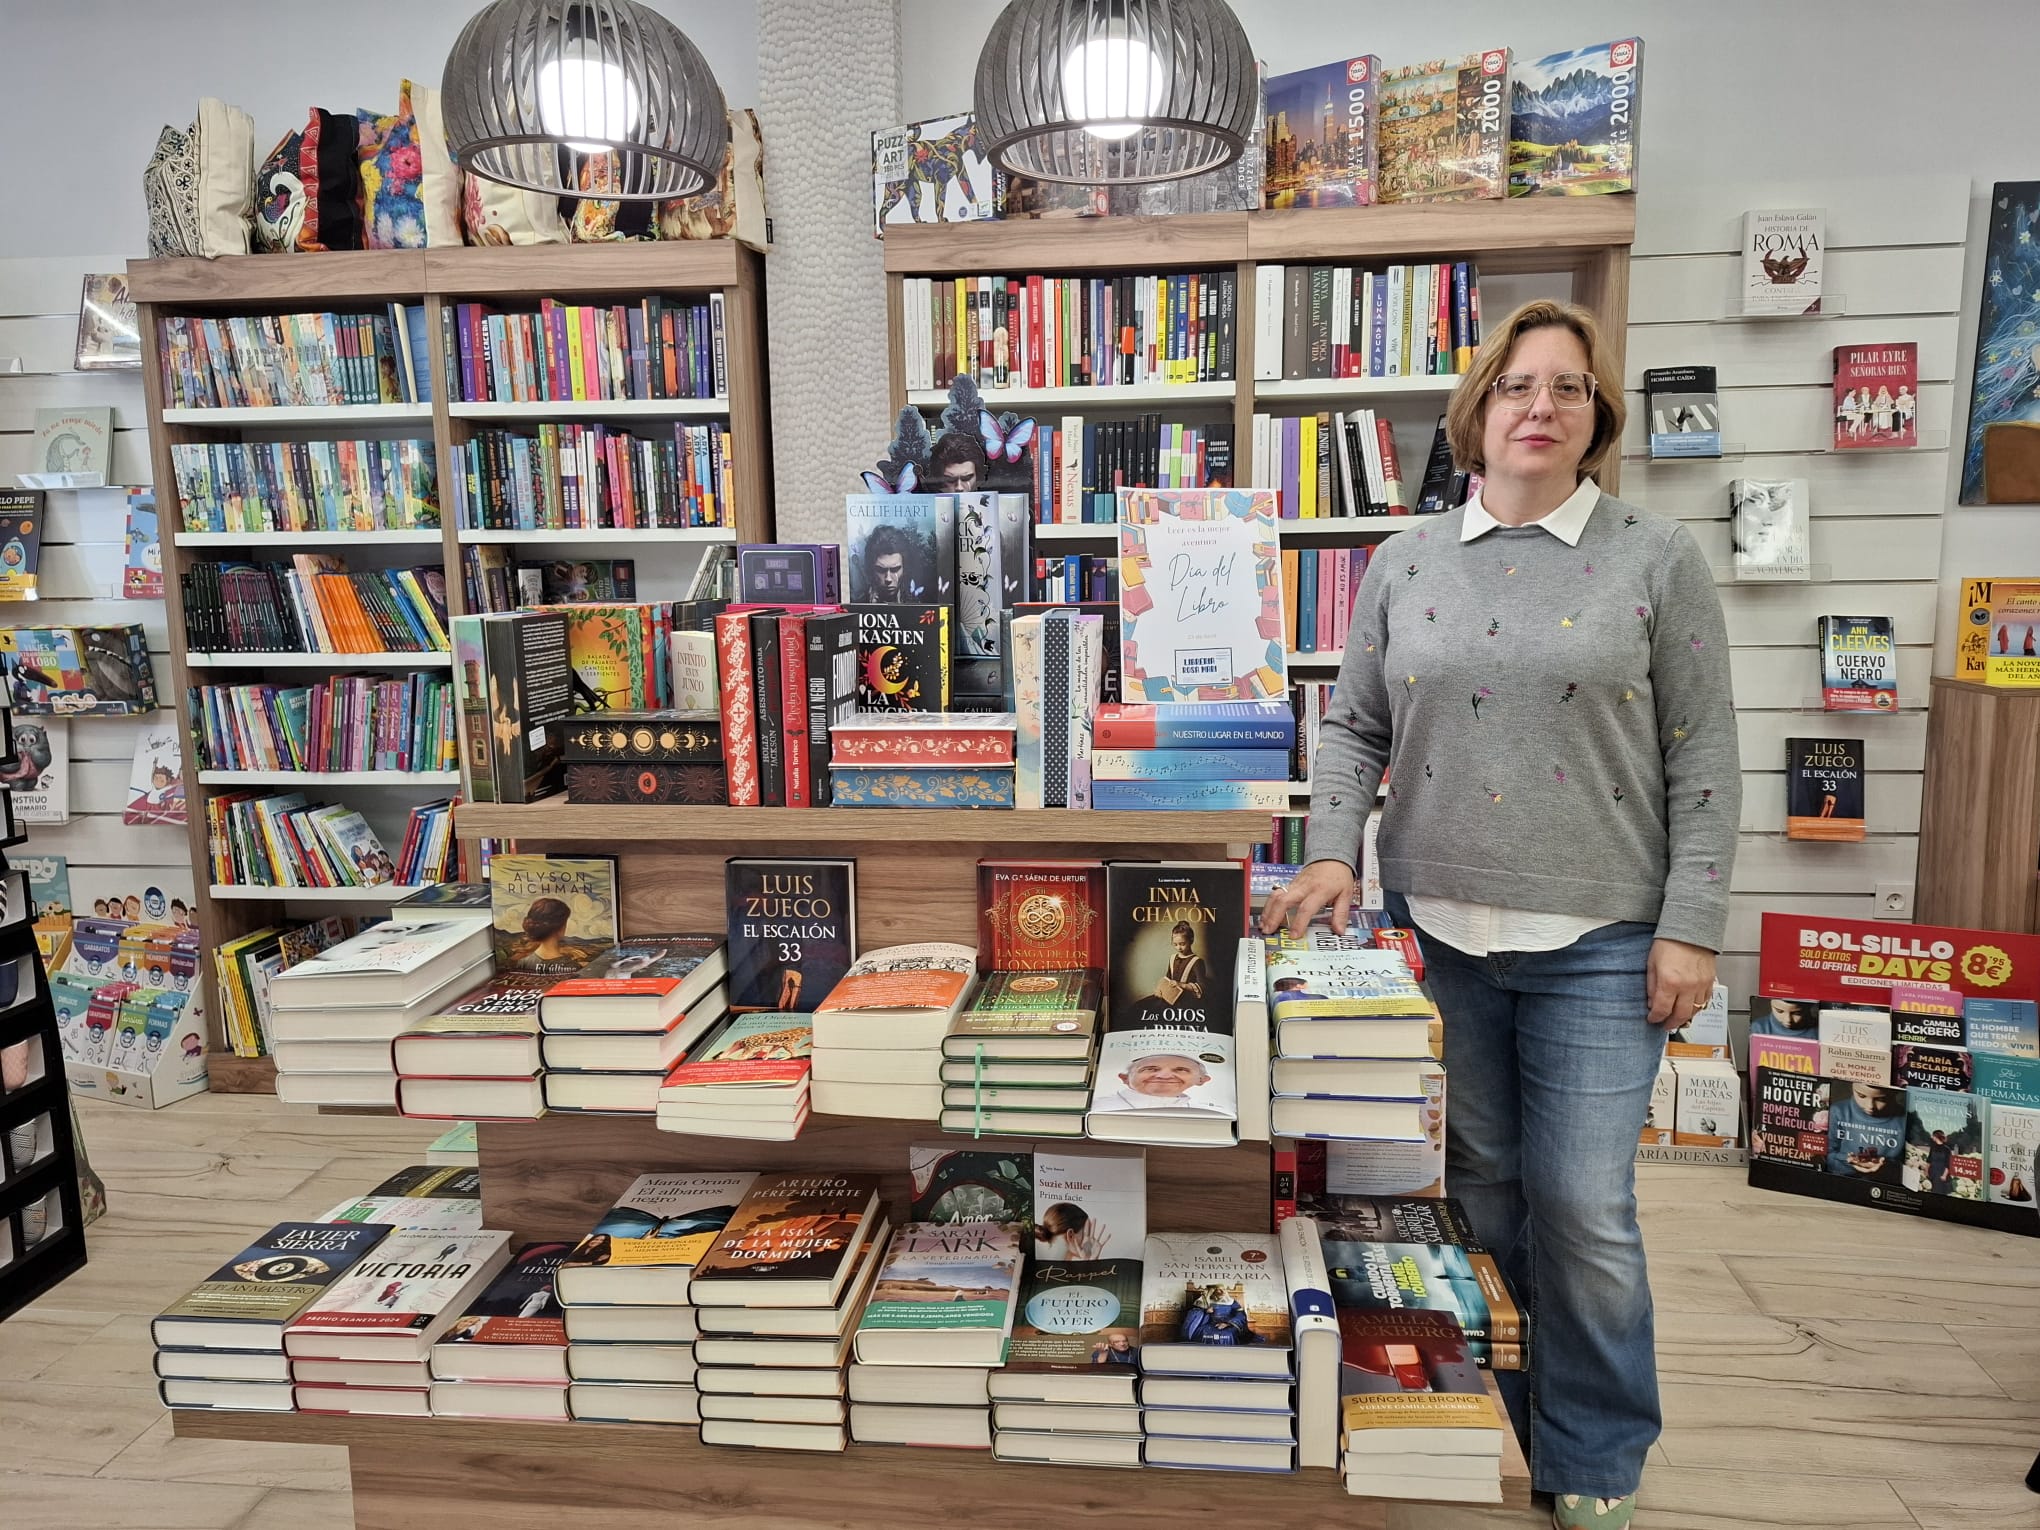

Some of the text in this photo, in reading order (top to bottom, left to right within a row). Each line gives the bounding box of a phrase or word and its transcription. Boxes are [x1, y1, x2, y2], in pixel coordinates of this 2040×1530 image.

[1610, 71, 1629, 126] 2000
[1482, 79, 1501, 133] 2000
[1349, 88, 1365, 140] 1500
[883, 150, 905, 165] ART
[1753, 233, 1820, 252] ROMA
[1320, 270, 1329, 300] HANYA
[1850, 350, 1907, 364] PILAR EYRE
[1850, 364, 1907, 377] SEÑORAS BIEN
[850, 504, 929, 518] CALLIE HART
[1212, 552, 1236, 587] del
[1176, 586, 1230, 623] Libro
[859, 612, 899, 629] IONA
[1851, 626, 1868, 635] ANN
[859, 630, 925, 645] KASTEN
[1830, 635, 1890, 652] CLEEVES
[32, 656, 57, 667] LOBO
[677, 652, 707, 668] INFINITO
[1836, 655, 1886, 668] CUERVO
[1841, 668, 1883, 681] NEGRO
[682, 679, 705, 692] JUNCO
[758, 666, 767, 721] ASESINATO
[810, 677, 827, 744] FUNDIDO NEGRO
[1172, 730, 1285, 740] NUESTRO LUGAR EN EL MUNDO
[1815, 743, 1845, 755] LUIS
[791, 739, 800, 789] Natalia Torvisco
[1804, 755, 1855, 768] ZUECO
[1814, 769, 1857, 779] ESCALÓN
[1822, 780, 1837, 791] 33
[514, 872, 586, 882] ALYSON
[995, 873, 1048, 881] EVA SÁENZ
[508, 883, 593, 894] RICHMAN
[762, 875, 814, 895] LUIS
[1149, 887, 1200, 903] INMA
[746, 898, 831, 918] ZUECO
[1132, 904, 1217, 924] CHACÓN
[743, 923, 836, 939] EL ESCALÓN
[1799, 929, 1955, 960] BOLSILLO
[778, 943, 802, 962] 33
[1800, 948, 1851, 963] SOLO ÉXITOS
[1799, 959, 1857, 973] SOLO OFERTAS
[1858, 955, 1952, 982] DAYS
[1847, 977, 1894, 988] EDICIONES
[1141, 1008, 1206, 1023] Los OJOS
[1841, 1023, 1870, 1036] LUIS
[1898, 1023, 1961, 1038] LÄCKBERG
[1923, 1019, 1960, 1029] CAMILLA
[1984, 1024, 2020, 1033] HOMBRE
[1898, 1034, 1927, 1042] HENRIK
[1970, 1031, 2017, 1041] QUE TENÍA
[1108, 1039, 1227, 1051] ESPERANZA
[1970, 1039, 2035, 1051] MIEDO VIVIR
[1828, 1047, 1886, 1062] Robin Sharma
[1919, 1054, 1952, 1065] MARÍA
[1759, 1050, 1815, 1075] ADICTA
[1851, 1063, 1877, 1071] MONJE
[1910, 1062, 1960, 1075] ESCLAPEZ
[1850, 1069, 1882, 1080] VENDIÓ
[1907, 1071, 1961, 1086] MUJERES
[1690, 1077, 1729, 1090] MARÍA
[1772, 1077, 1813, 1092] COLLEEN
[1993, 1079, 2023, 1090] SIETE
[1685, 1088, 1733, 1100] DUEÑAS
[1763, 1086, 1821, 1108] HOOVER
[1976, 1087, 2040, 1102] HERMANAS
[1763, 1102, 1800, 1117] ROMPER
[1762, 1113, 1815, 1132] EL CÍRCULO
[2004, 1116, 2033, 1129] LUIS
[1761, 1132, 1795, 1147] VOLVER
[1836, 1129, 1898, 1149] EL NIÑO
[1673, 1150, 1729, 1163] DUEÑAS
[1768, 1145, 1812, 1162] EMPEZAR
[2002, 1160, 2034, 1173] REINA
[645, 1178, 741, 1186] María Oruña
[776, 1178, 848, 1188] ARTURO
[1039, 1178, 1092, 1191] Suzie Miller
[637, 1187, 724, 1195] El albatros
[752, 1188, 863, 1199] PÉREZ-REVERTE
[1039, 1190, 1083, 1202] Prima facie
[631, 1196, 677, 1204] negro
[1402, 1203, 1428, 1244] GABRIELA
[1417, 1205, 1444, 1243] SALAZAR
[281, 1229, 361, 1241] JAVIER
[753, 1228, 816, 1237] LA ISLA
[928, 1230, 987, 1238] SARAH
[270, 1239, 348, 1250] SIERRA
[723, 1239, 833, 1249] DE LA MUJER
[908, 1238, 1001, 1253] LARK
[730, 1250, 812, 1259] DORMIDA
[354, 1263, 472, 1279] VICTORIA
[1035, 1265, 1118, 1283] Rappel
[1183, 1271, 1272, 1280] TEMERARIA
[1391, 1262, 1411, 1291] MANEL
[1401, 1255, 1429, 1298] LOUREIRO
[1367, 1262, 1389, 1300] CUANDO
[1040, 1298, 1109, 1308] FUTURO
[1049, 1316, 1094, 1326] AYER
[1352, 1395, 1484, 1405] SUEÑOS DE BRONCE
